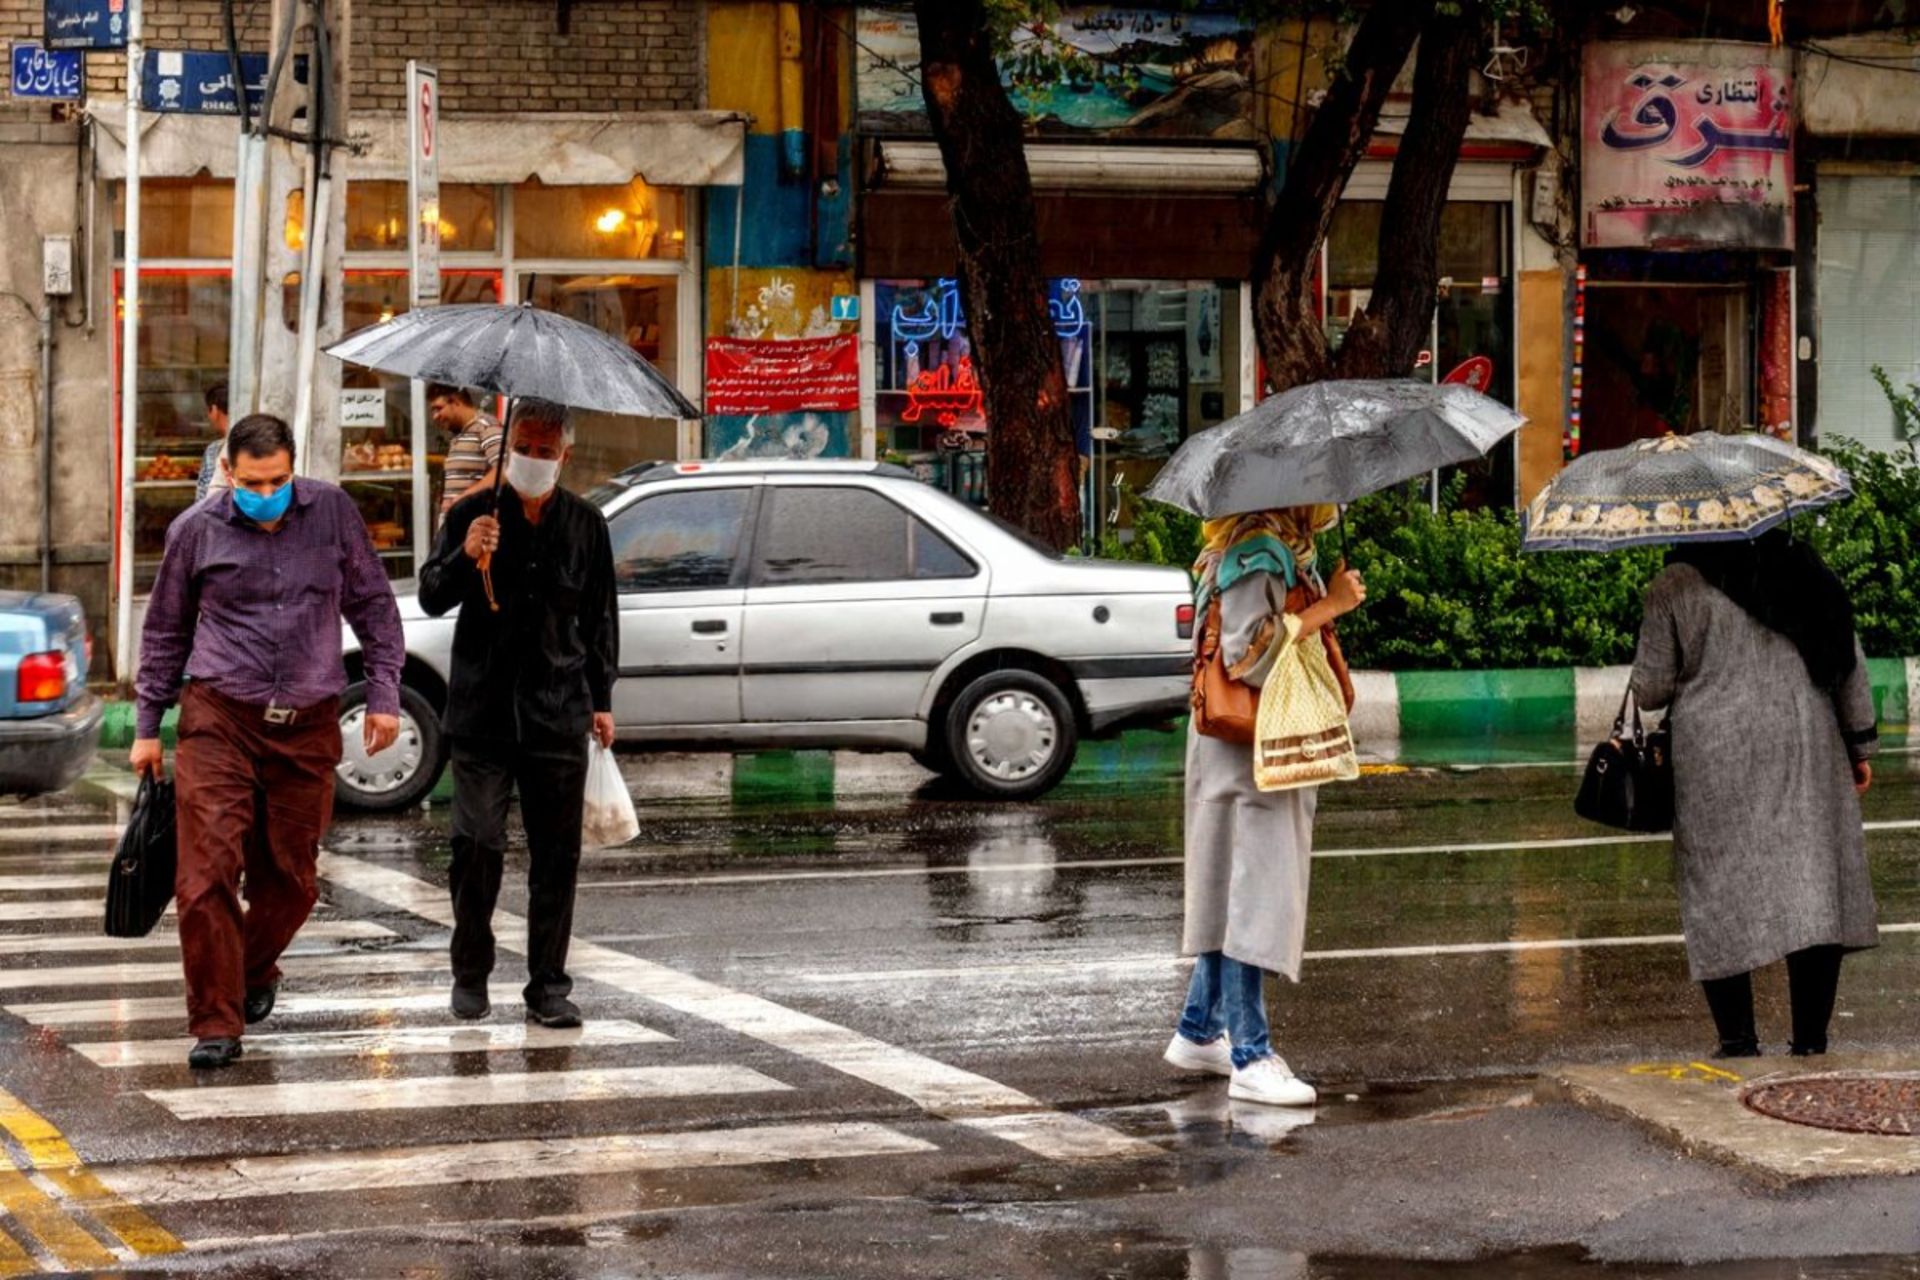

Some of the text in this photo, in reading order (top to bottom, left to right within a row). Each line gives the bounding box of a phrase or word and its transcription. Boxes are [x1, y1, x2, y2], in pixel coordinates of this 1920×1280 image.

[16, 48, 80, 95] خیابان خاقانی
[1696, 78, 1764, 105] انتظاری
